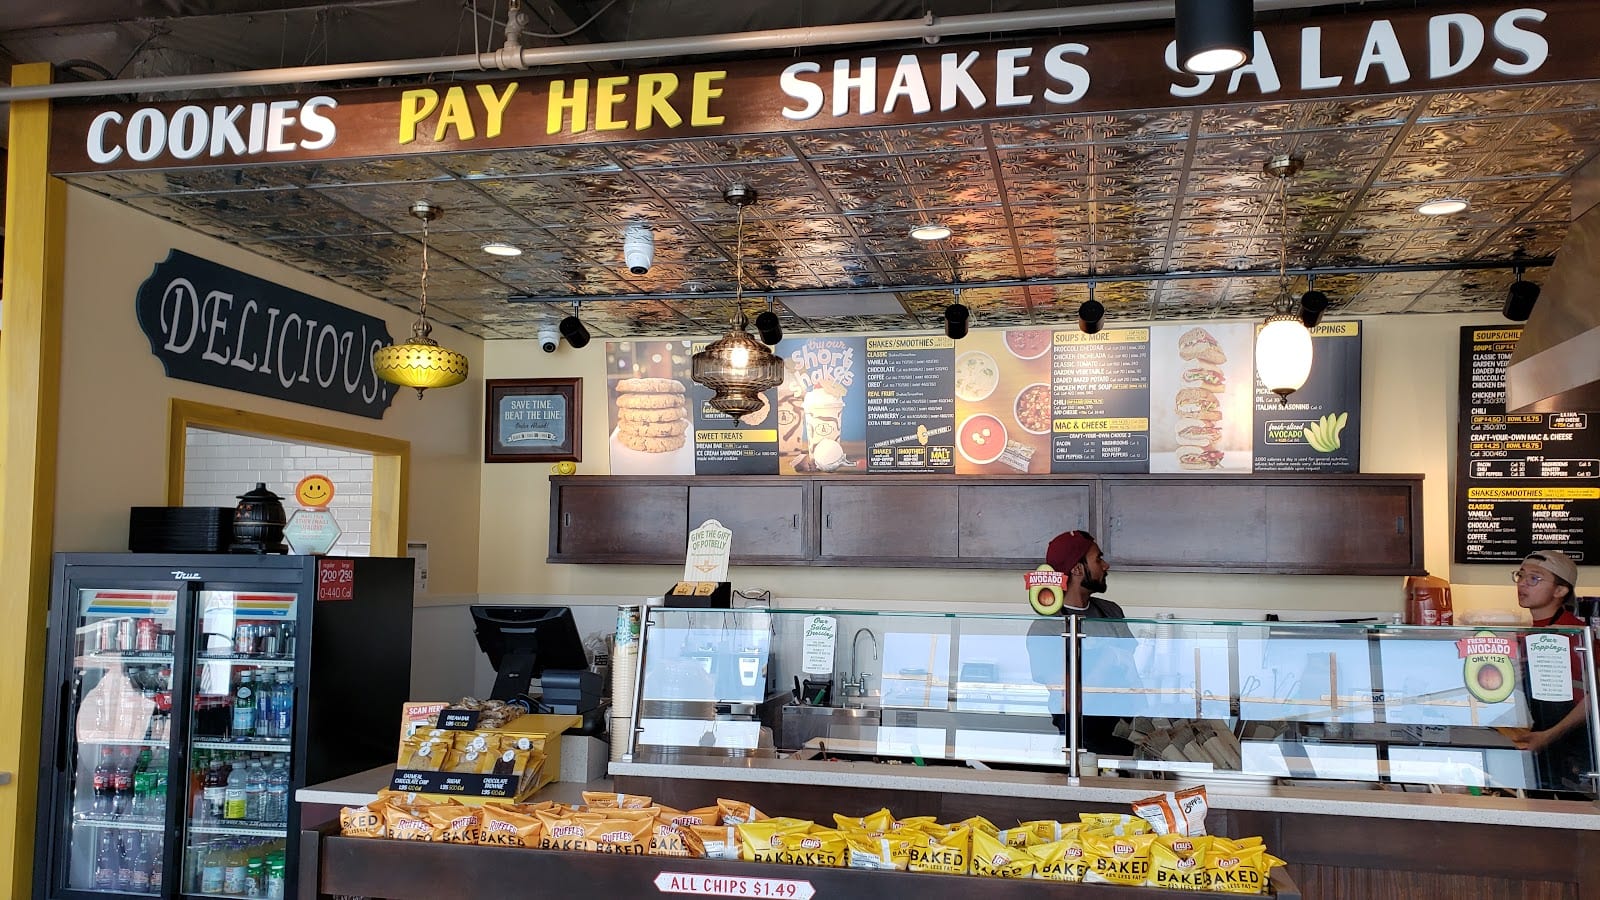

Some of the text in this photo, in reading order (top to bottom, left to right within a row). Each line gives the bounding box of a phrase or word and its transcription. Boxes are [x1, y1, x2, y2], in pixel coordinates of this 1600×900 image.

[780, 43, 1091, 120] SHAKES
[399, 70, 728, 145] PAY HERE
[87, 95, 338, 165] COOKIES
[1310, 325, 1346, 334] OPPINGS
[1476, 331, 1520, 340] SOUPS/CHIL
[1055, 332, 1110, 343] SOUPS MORE
[868, 339, 934, 349] SHAKES/SMOOTHIES
[791, 345, 854, 370] short
[788, 364, 855, 398] shakes
[511, 400, 530, 410] SAVE
[504, 410, 524, 420] BEAT
[526, 410, 541, 420] THE
[1055, 422, 1072, 430] MAC
[1081, 420, 1108, 429] CHEESE
[697, 432, 743, 440] SWEET TREATS
[1269, 430, 1303, 438] AVOCADO
[1471, 433, 1526, 441] CRAFT-YOUR-OWN
[931, 451, 951, 459] MALT
[1471, 489, 1543, 497] SHAKES/SMOOTHIES
[691, 529, 731, 542] GIVE THE GIFT
[692, 539, 727, 551] OF POTBELLY
[171, 570, 202, 579] True
[1029, 575, 1063, 584] AVOCADO
[320, 586, 352, 599] 0-440 Cal
[811, 623, 833, 631] Salad
[1539, 635, 1558, 643] Our
[1467, 644, 1511, 655] AVOCADO
[1530, 643, 1567, 653] Toppings
[408, 706, 428, 715] SCAN
[399, 818, 431, 832] RUFFLES
[451, 815, 479, 831] RUFFLES
[489, 820, 518, 835] RUFFLES
[442, 828, 479, 842] BAKE
[552, 826, 585, 838] RUFFLES
[602, 831, 633, 843] RUFFLES
[542, 838, 587, 851] BAKE
[596, 843, 644, 857] BAKED
[787, 851, 836, 866] BAKED
[910, 849, 963, 866] BAKED
[1043, 863, 1091, 877] BAKE
[1097, 858, 1149, 875] BAKED
[1206, 870, 1259, 886] BAKED
[671, 876, 796, 897] ALL CHIPS $1.49
